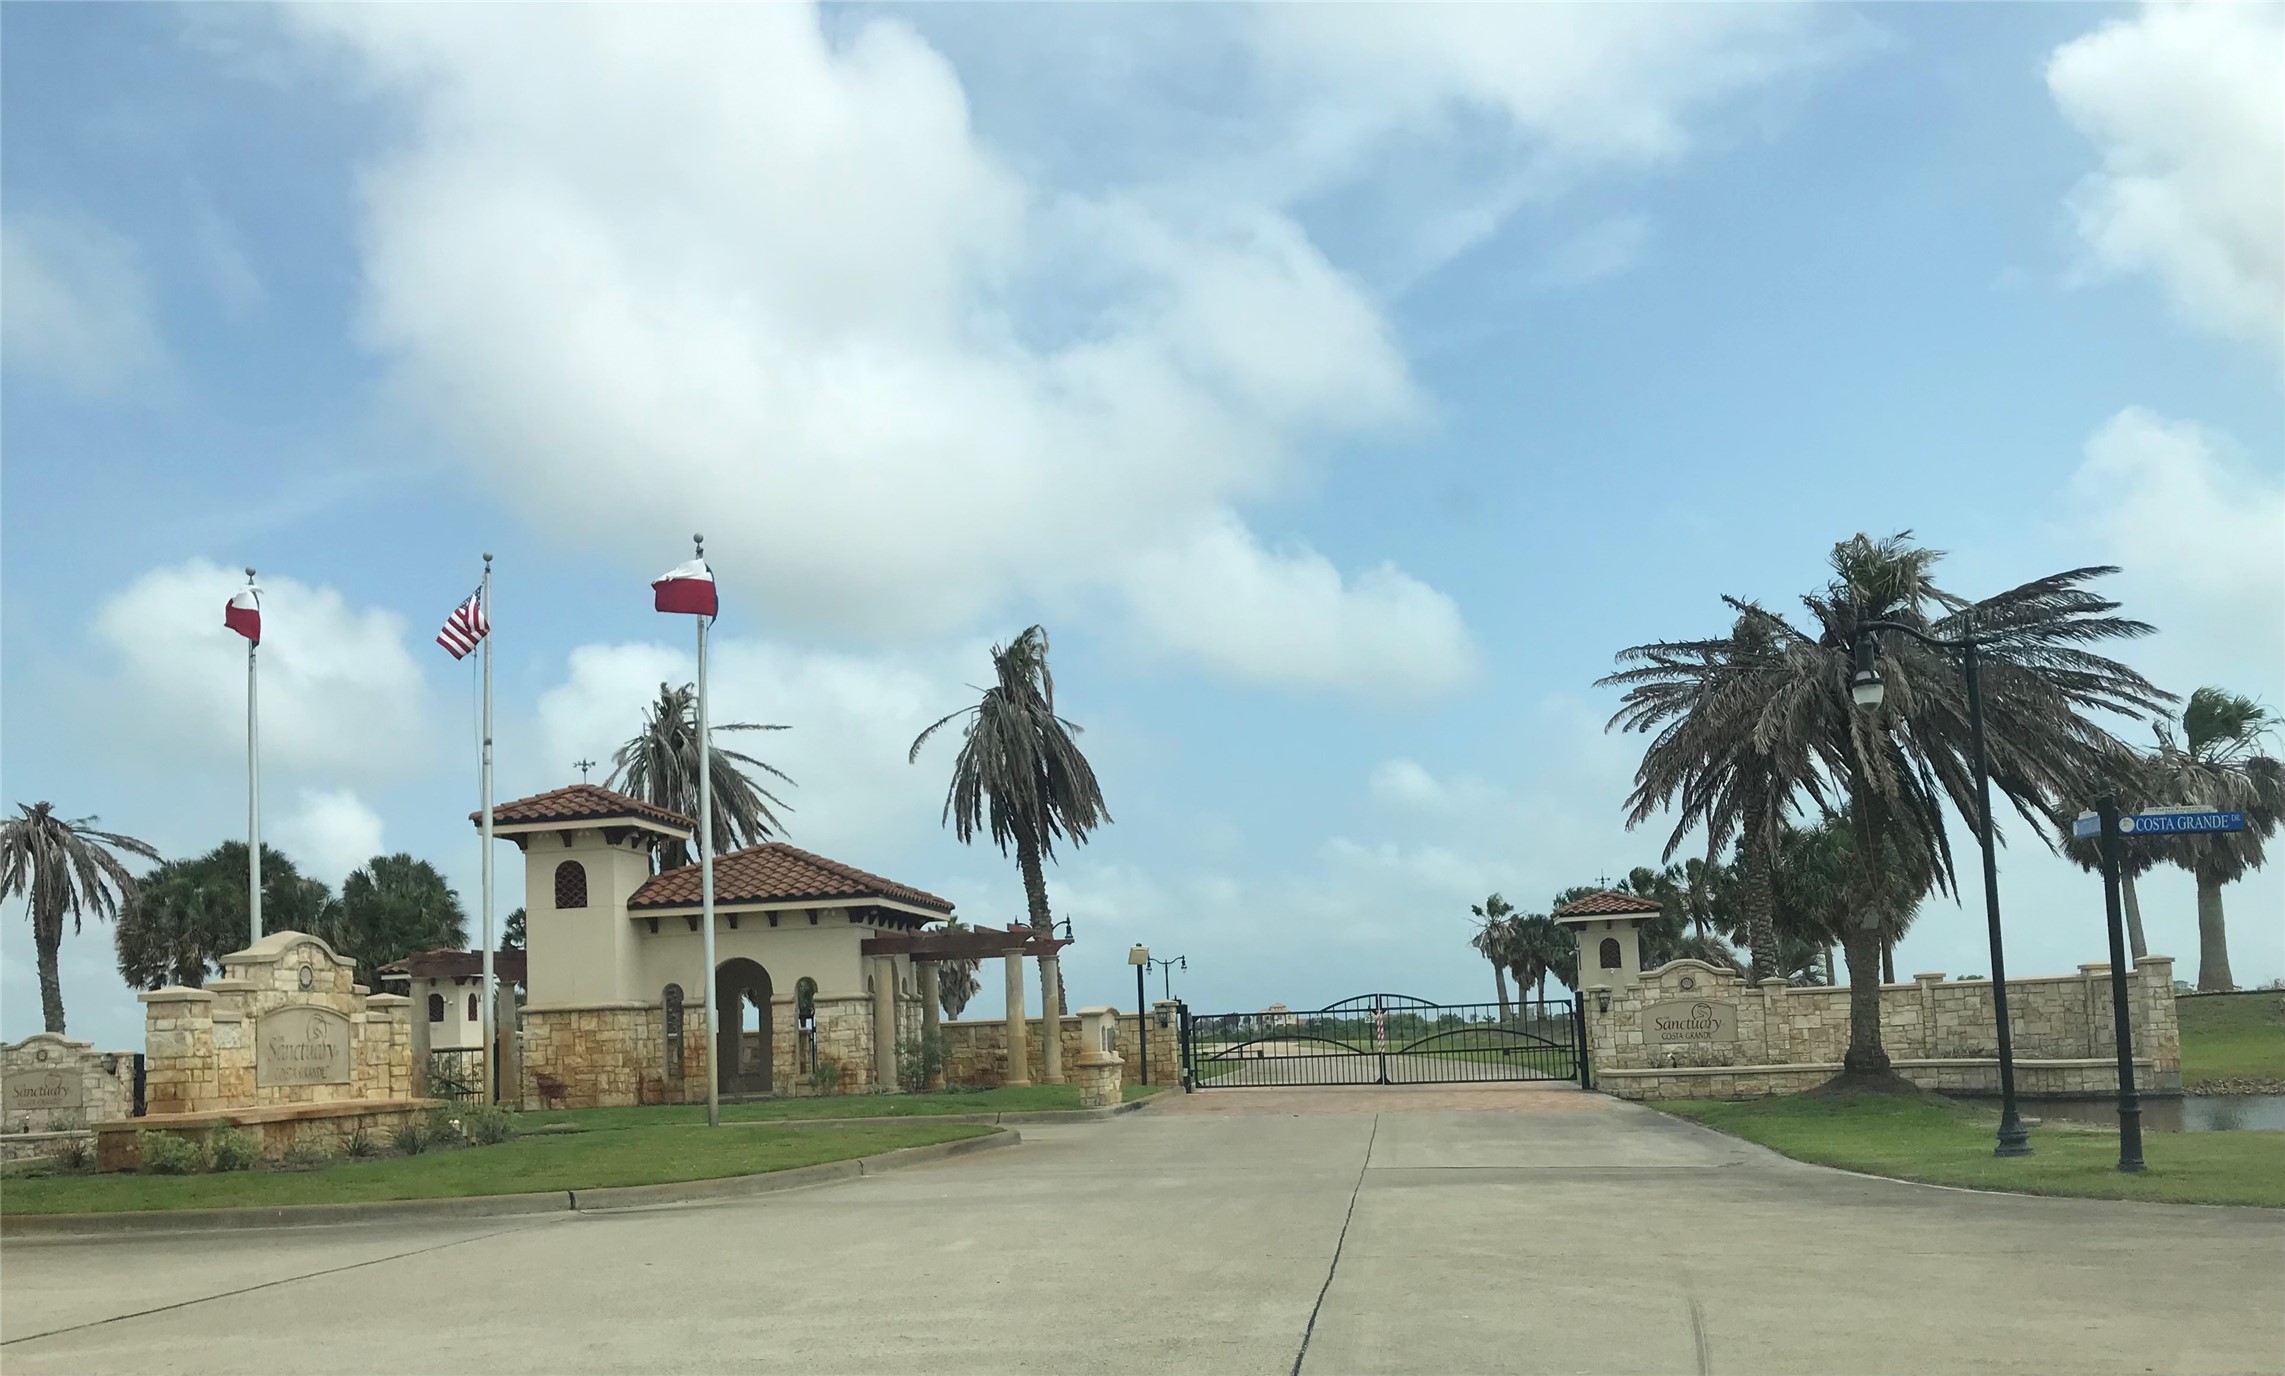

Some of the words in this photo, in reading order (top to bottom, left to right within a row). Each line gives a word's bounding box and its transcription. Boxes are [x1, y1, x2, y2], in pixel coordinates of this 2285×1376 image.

[2136, 817, 2175, 832] COSTA
[2177, 815, 2229, 830] GRANDE
[1654, 1017, 1722, 1033] Sanctuary
[1661, 1032, 1684, 1040] COSTA
[1685, 1031, 1712, 1039] GRANDE
[267, 1040, 336, 1062] Sanctuary
[12, 1084, 69, 1098] Sanctuary
